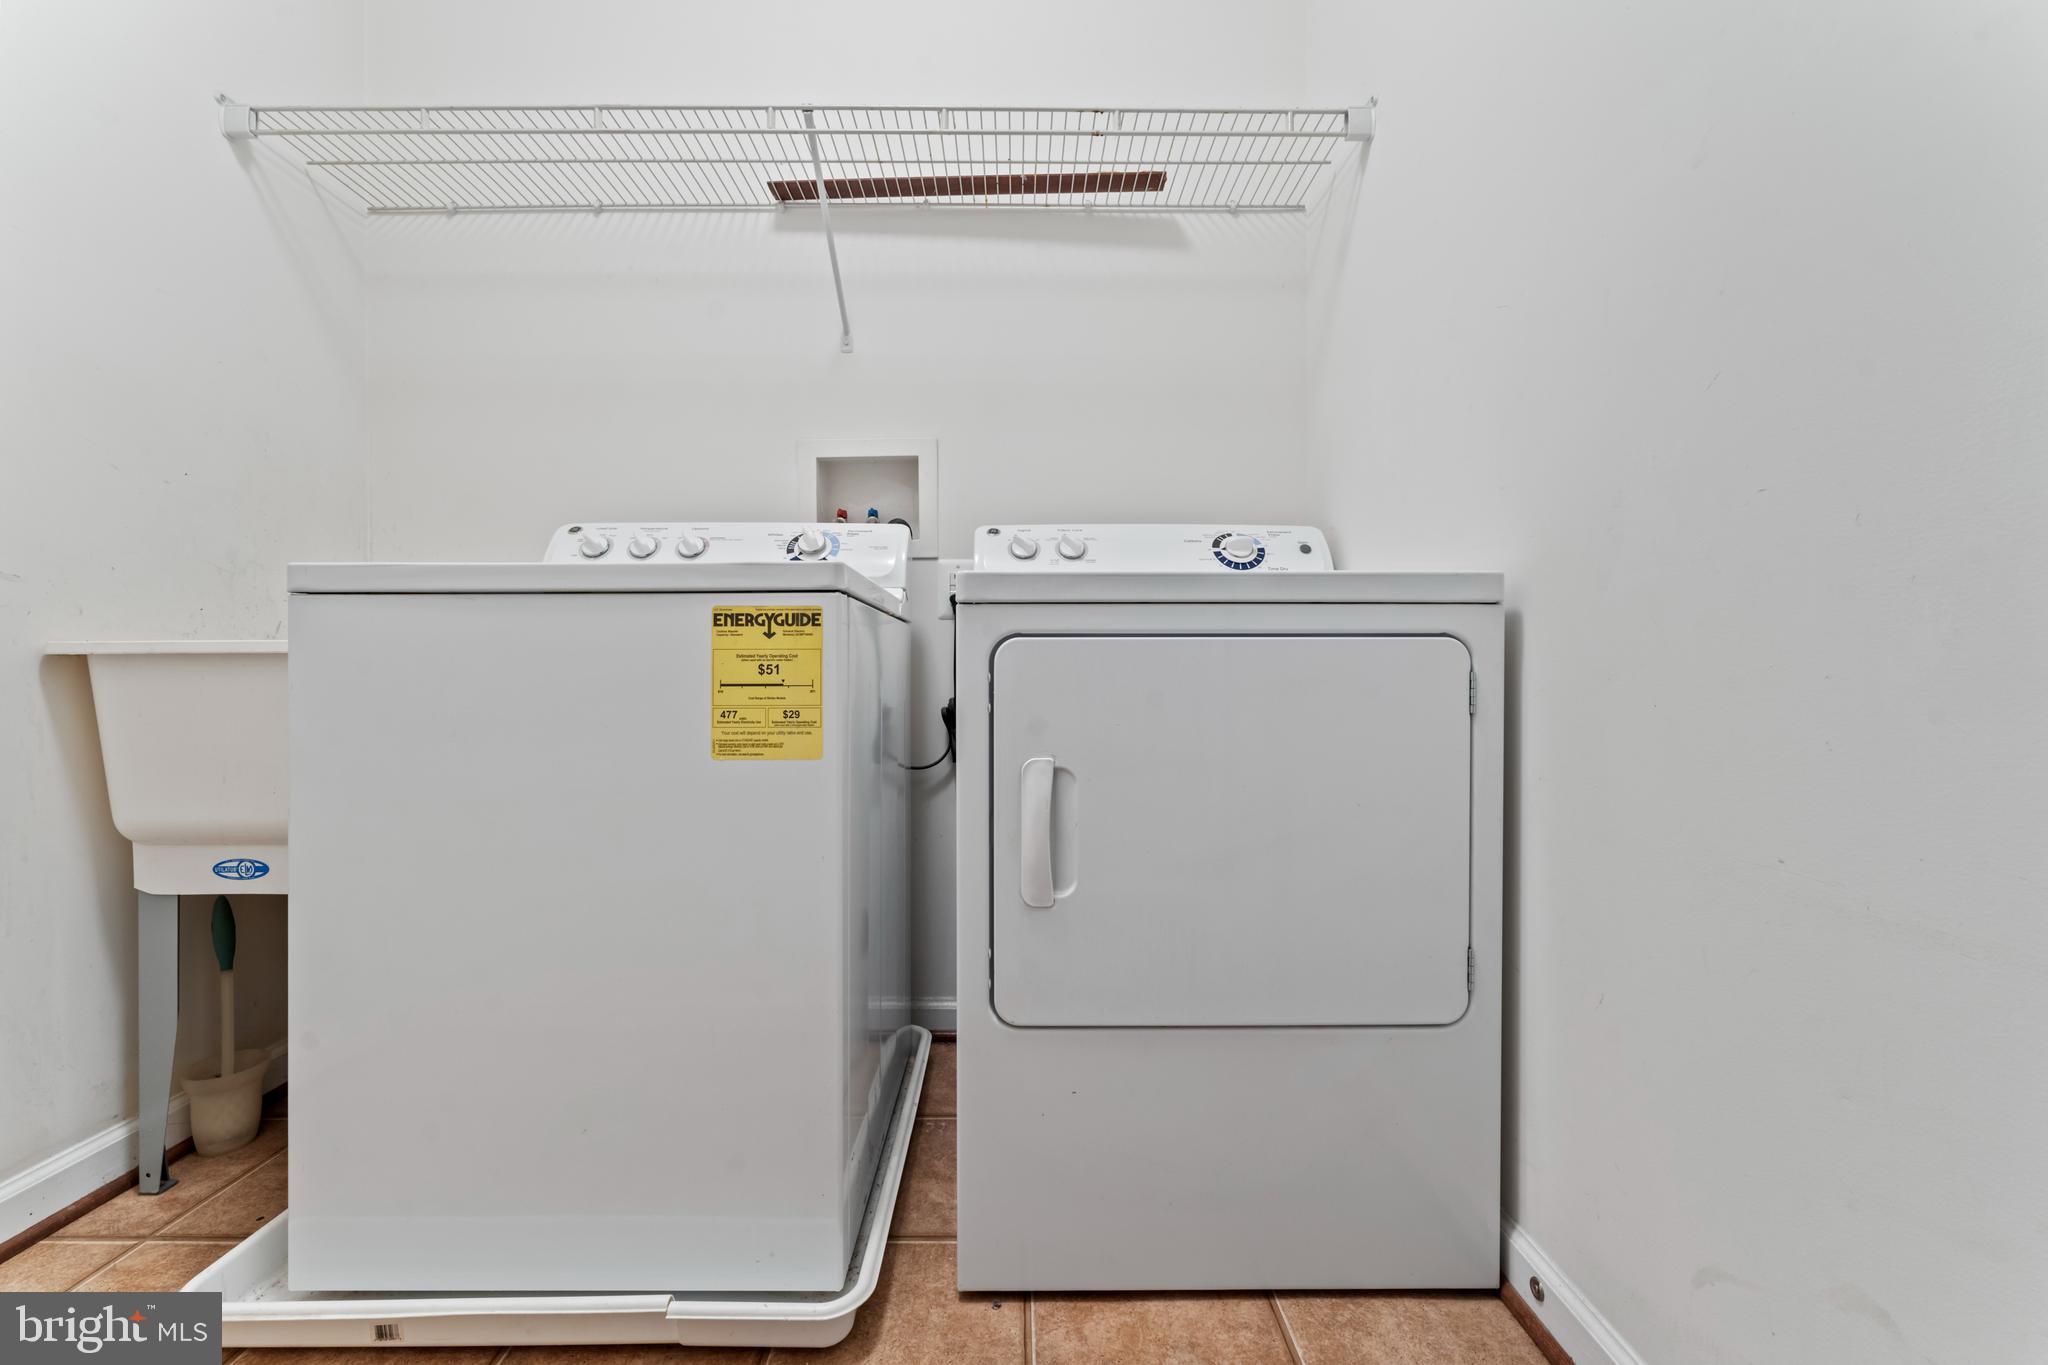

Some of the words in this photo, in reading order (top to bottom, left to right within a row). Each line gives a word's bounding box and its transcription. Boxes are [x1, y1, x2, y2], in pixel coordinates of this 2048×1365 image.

[713, 612, 821, 629] ENERGYGUIDE
[758, 664, 780, 676] $51
[720, 710, 738, 719] 477
[783, 709, 800, 719] $29
